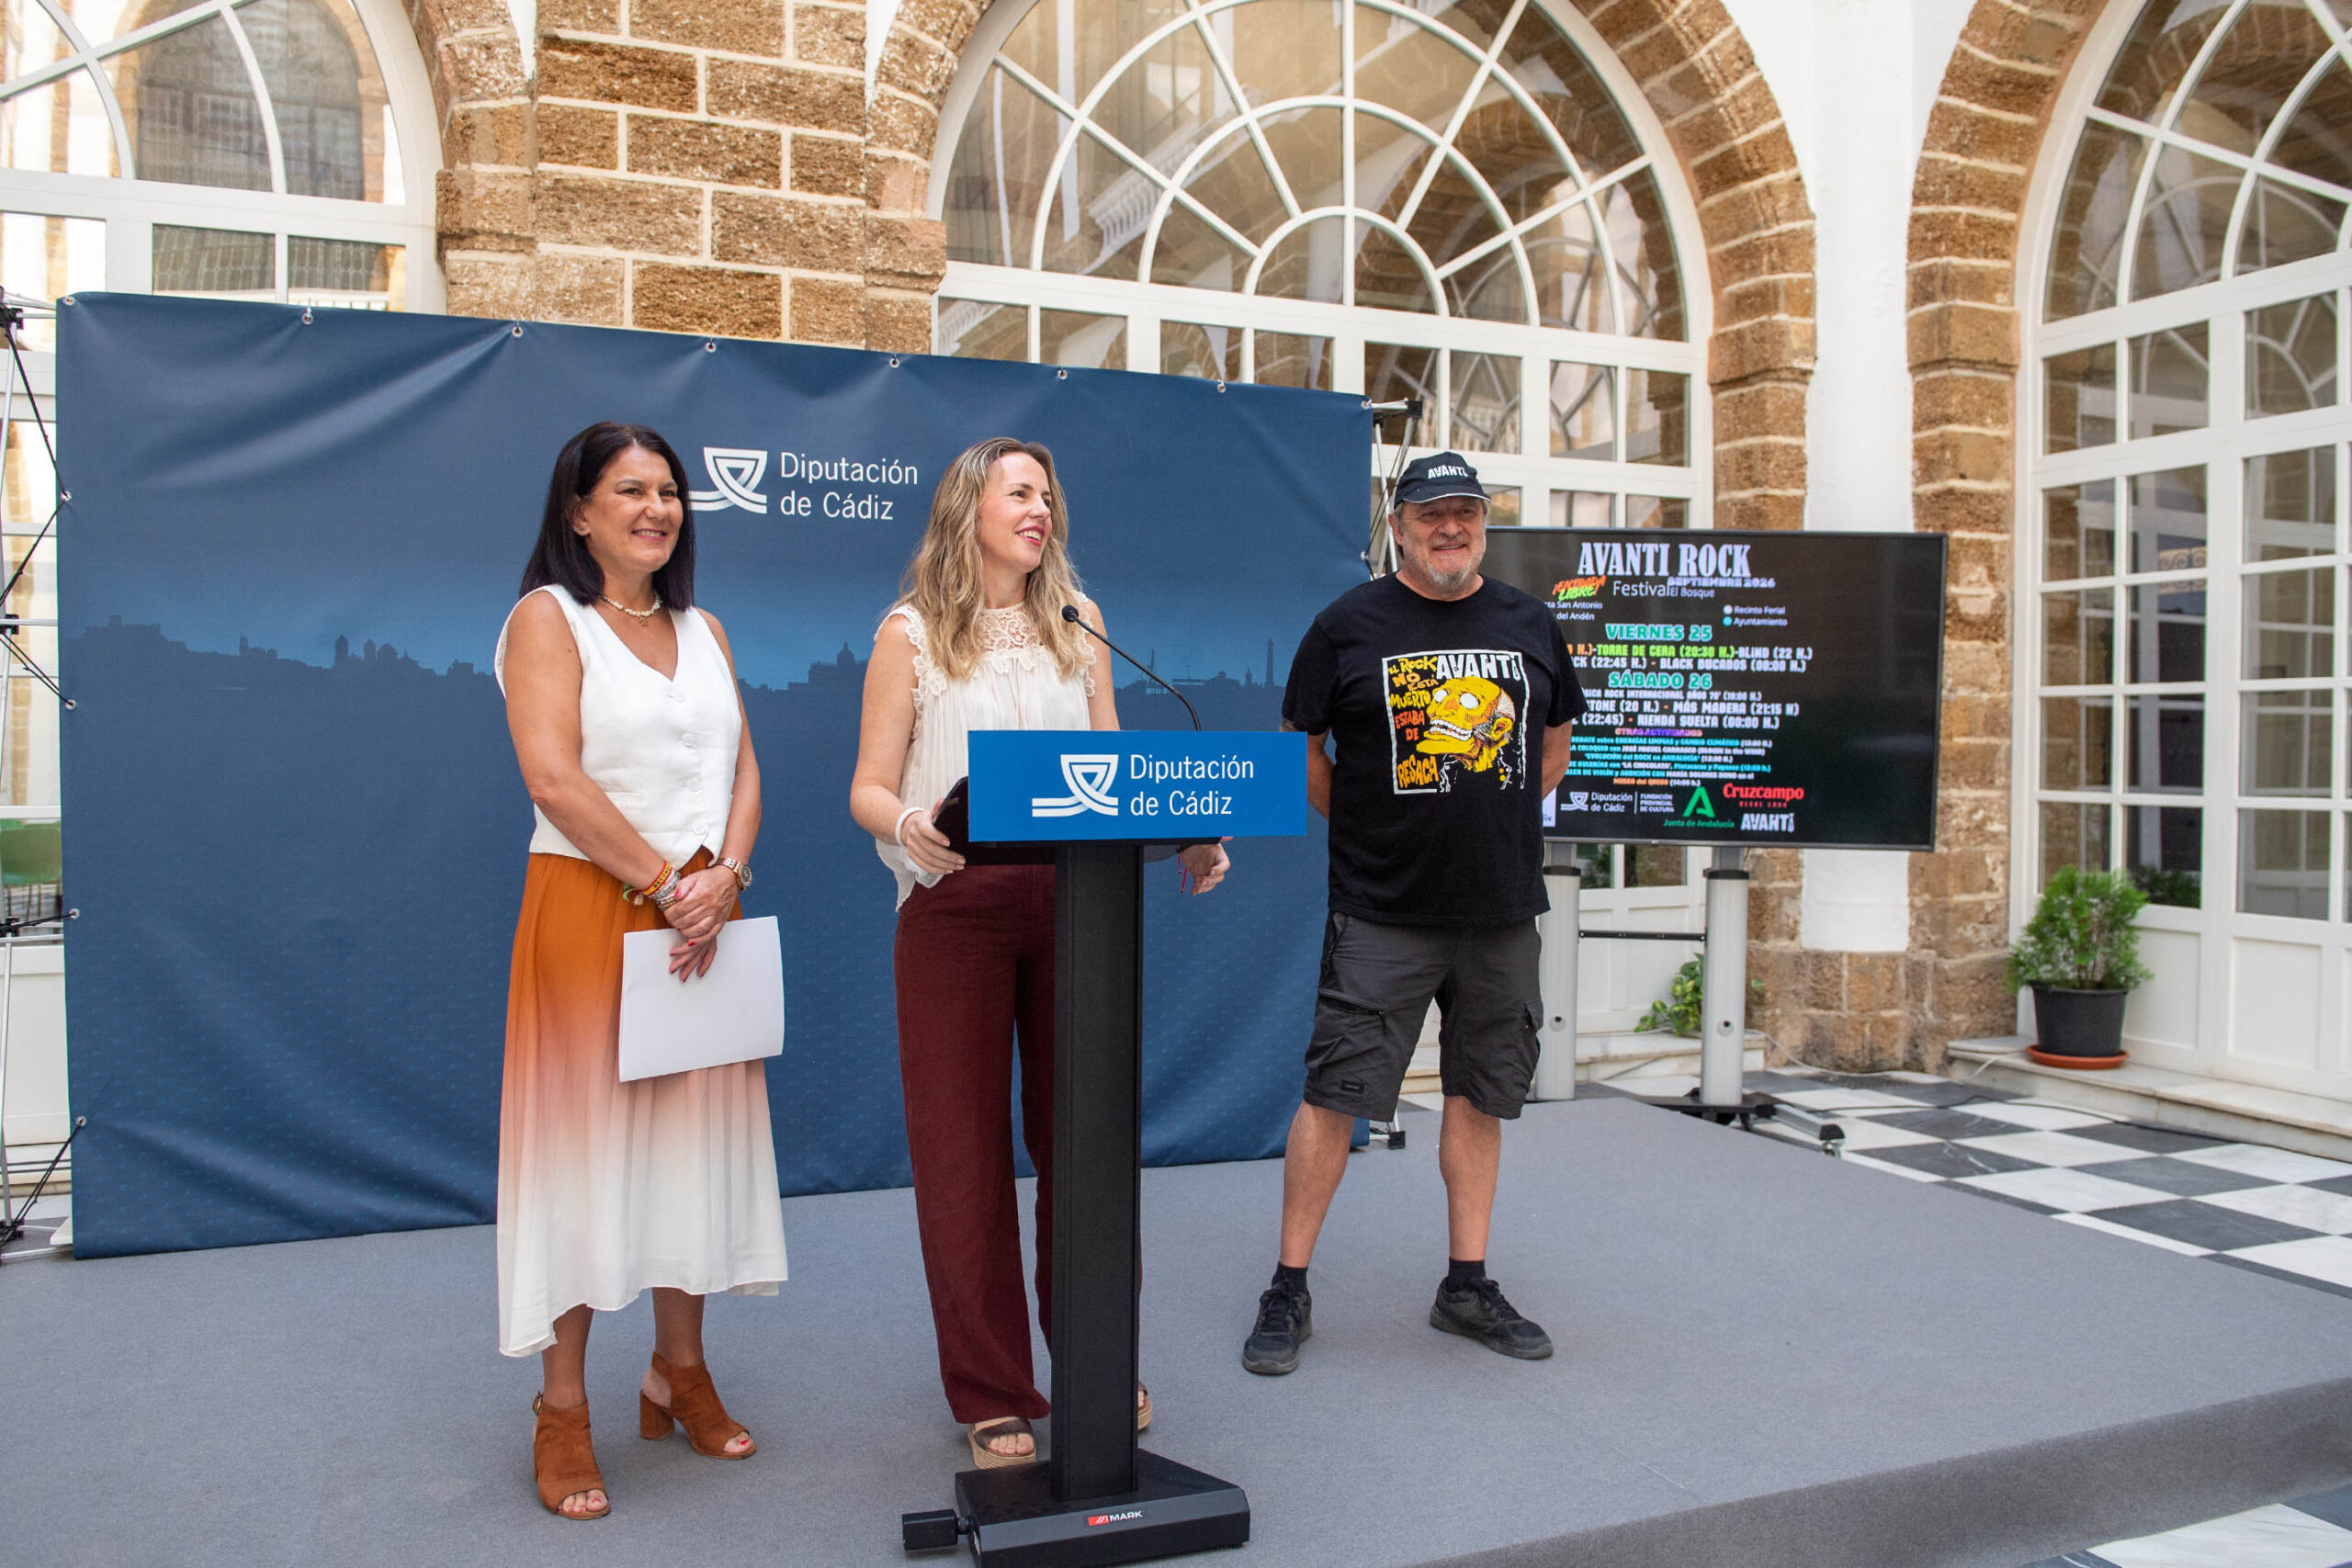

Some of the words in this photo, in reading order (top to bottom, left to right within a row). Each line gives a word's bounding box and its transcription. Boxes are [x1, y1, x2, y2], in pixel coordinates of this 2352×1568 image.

[781, 452, 918, 485] Diputación
[1428, 465, 1468, 479] AVANTI
[781, 491, 811, 516] de
[823, 491, 894, 520] Cádiz
[1577, 542, 1670, 576] AVANTI
[1678, 543, 1751, 578] ROCK
[1612, 581, 1670, 597] Festival
[1680, 588, 1715, 600] Bosque
[1557, 600, 1571, 609] San
[1572, 601, 1603, 610] Antonio
[1734, 605, 1763, 615] Recinto
[1764, 605, 1786, 615] Ferial
[1556, 612, 1568, 620] del
[1570, 611, 1596, 621] Andén
[1733, 616, 1789, 627] Ayuntamiento
[1605, 623, 1685, 641] VIERNES
[1689, 624, 1713, 642] 25
[1632, 645, 1646, 657] DE
[1649, 645, 1676, 658] CERA
[1398, 656, 1438, 673] ROCK
[1591, 656, 1627, 669] (22:45
[1660, 658, 1694, 670] BLACK
[1697, 659, 1747, 671] DUCADOS
[1392, 672, 1421, 688] NO
[1407, 675, 1440, 692] ESTÁ
[1608, 669, 1684, 689] SÁBADO
[1689, 672, 1713, 690] 26
[1389, 690, 1431, 709] MUERTO
[1604, 688, 1624, 698] ROCK
[1626, 689, 1685, 699] INTERNACIONAL
[1620, 699, 1640, 713] (20
[1672, 698, 1699, 714] MÁS
[1702, 701, 1747, 715] MADERA
[1395, 710, 1426, 729] ESTABA
[1582, 712, 1624, 727] (22:45)
[1637, 714, 1676, 727] RIENDA
[1679, 715, 1719, 728] SUELTA
[1406, 728, 1419, 741] DE
[1130, 754, 1254, 784] Diputación
[1396, 754, 1440, 788] RESACA
[1590, 792, 1633, 804] Diputación
[1723, 783, 1805, 802] Cruzcampo
[1130, 792, 1159, 816] de
[1169, 791, 1233, 816] Cádiz
[1590, 803, 1601, 812] de
[1602, 802, 1625, 813] Cádiz
[1663, 818, 1684, 828] Junta
[1697, 818, 1736, 829] Andalucía
[1109, 1510, 1144, 1522] MARK
